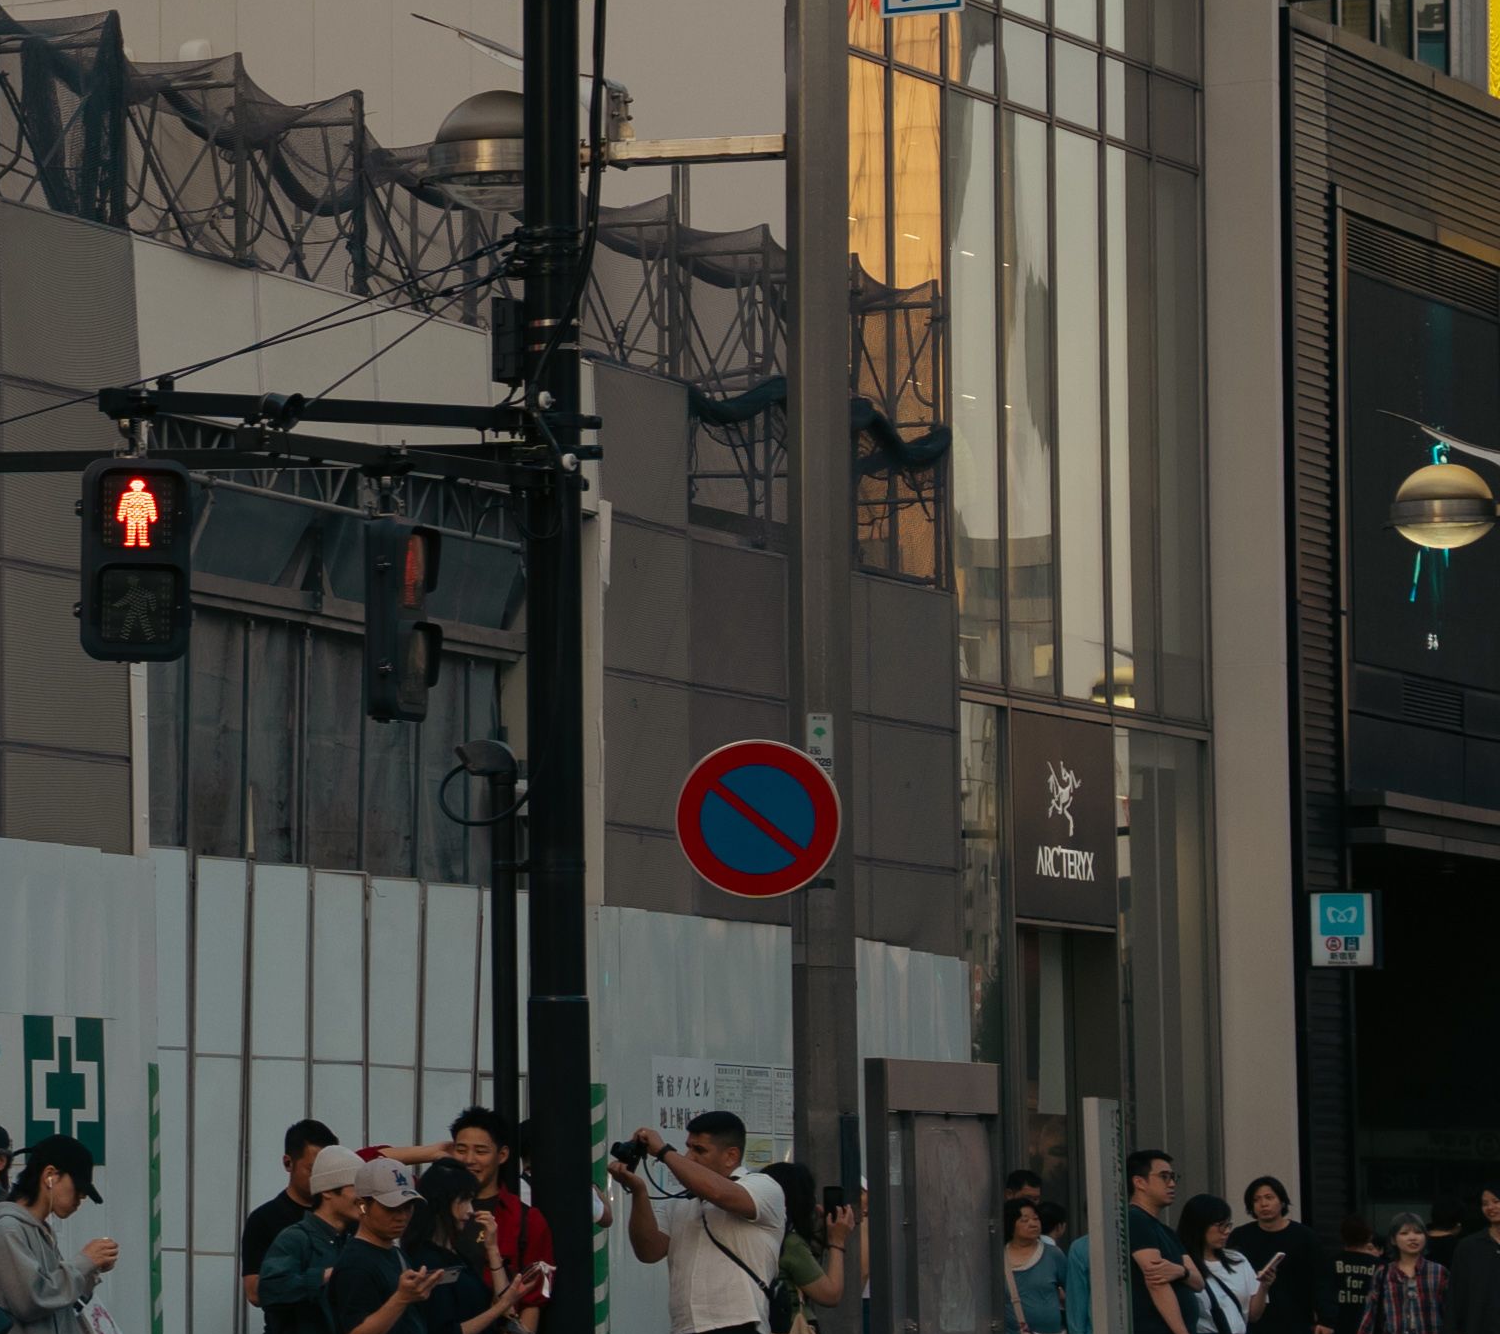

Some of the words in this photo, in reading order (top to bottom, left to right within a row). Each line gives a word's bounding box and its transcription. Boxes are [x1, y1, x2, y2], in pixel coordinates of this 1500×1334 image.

[1036, 844, 1095, 883] ARC'TERYX
[1336, 1261, 1376, 1276] Bound
[1346, 1275, 1364, 1290] for
